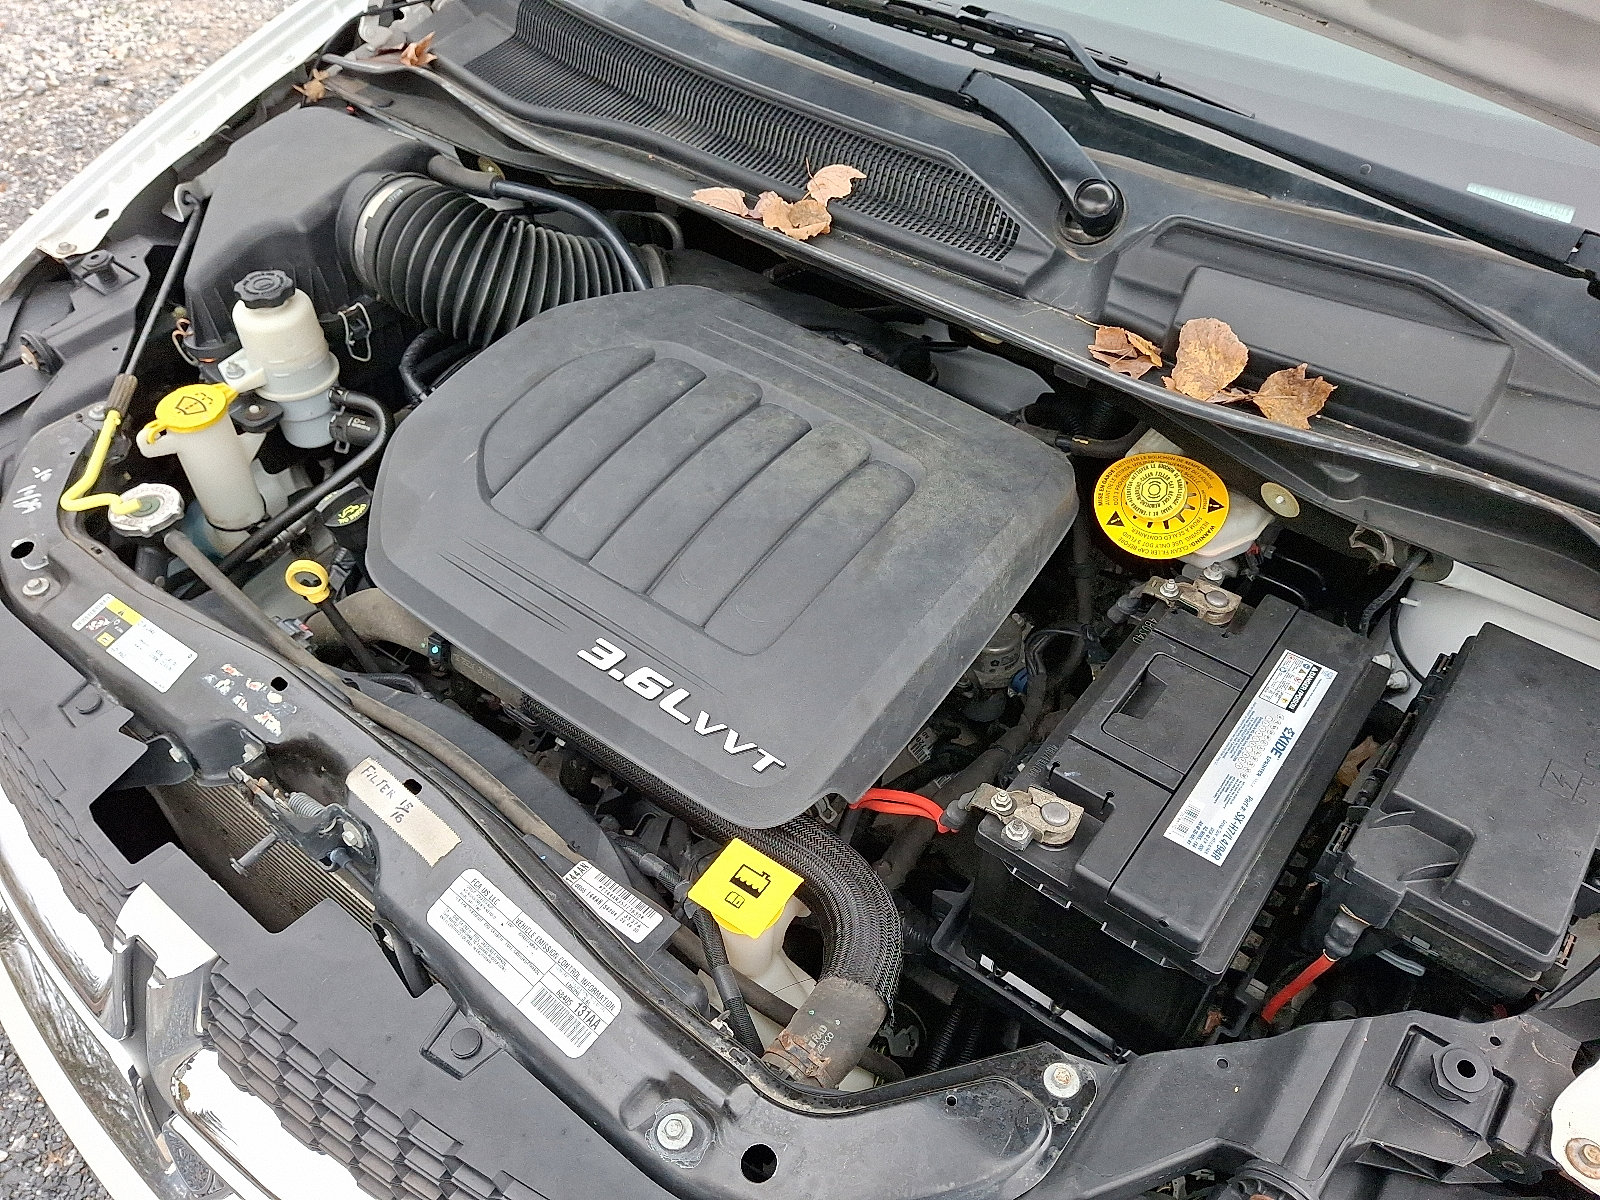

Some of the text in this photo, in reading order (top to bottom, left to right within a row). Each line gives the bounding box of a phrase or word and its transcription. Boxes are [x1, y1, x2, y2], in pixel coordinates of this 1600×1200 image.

[1270, 725, 1296, 759] EXIDE
[470, 877, 501, 906] FCA US LLC
[514, 917, 537, 939] VEHICLE
[533, 935, 560, 960] EMISSION
[557, 956, 583, 981] CONTROL
[579, 977, 616, 1012] INFORMATION
[572, 1001, 602, 1030] 131AA
